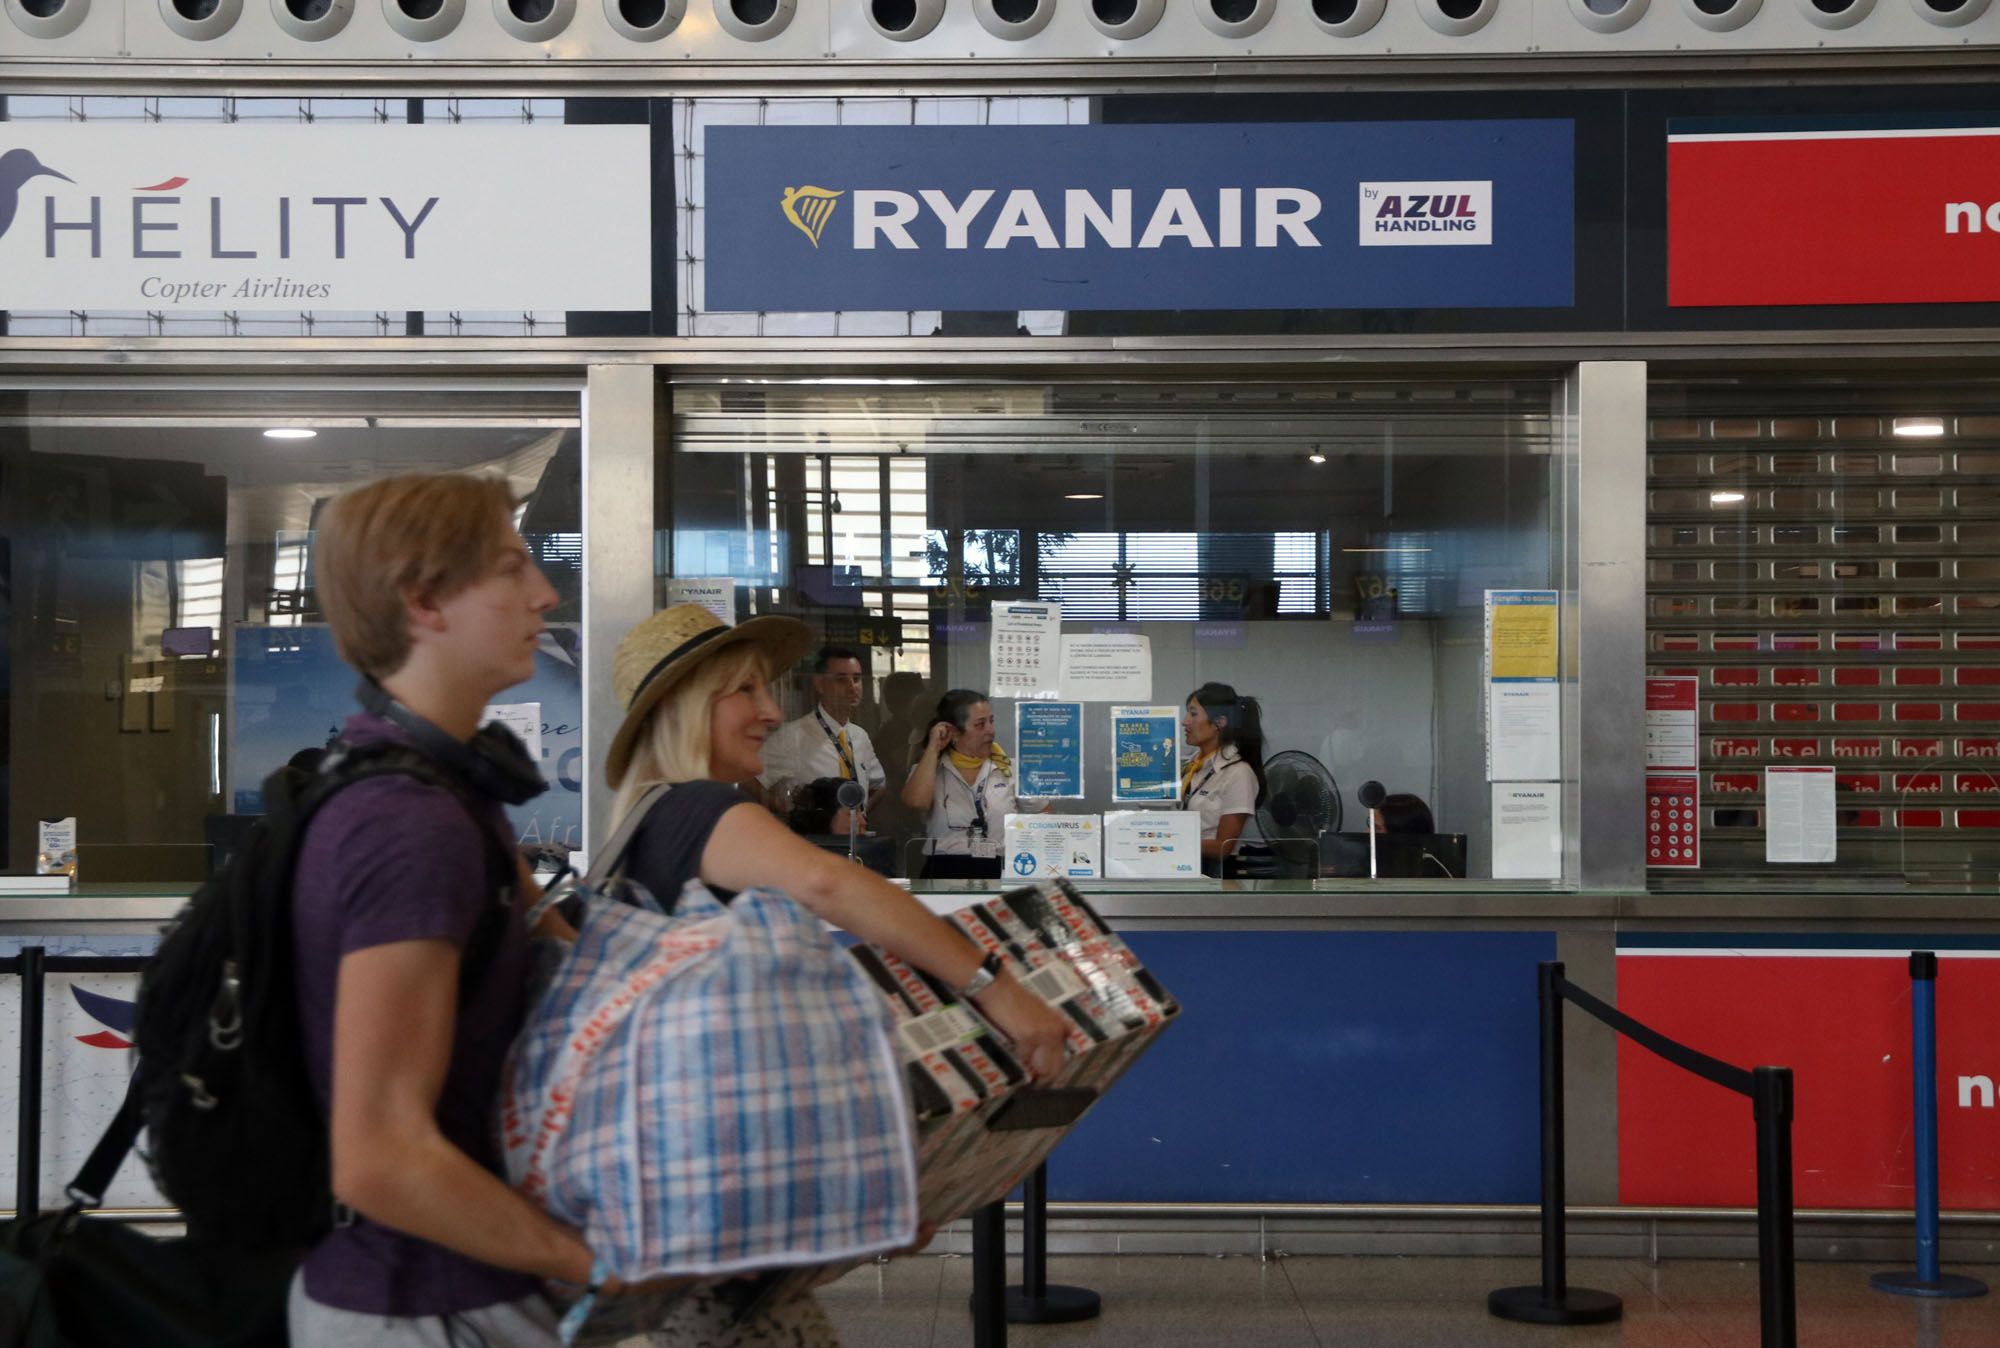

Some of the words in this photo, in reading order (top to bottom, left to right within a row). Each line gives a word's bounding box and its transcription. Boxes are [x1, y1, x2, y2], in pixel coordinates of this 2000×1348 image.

[1364, 188, 1379, 200] by
[1376, 195, 1477, 218] AZUL
[852, 187, 1322, 250] RYANAIR
[1375, 219, 1477, 232] HANDLING
[141, 276, 227, 304] Copter
[232, 276, 331, 298] Airlines
